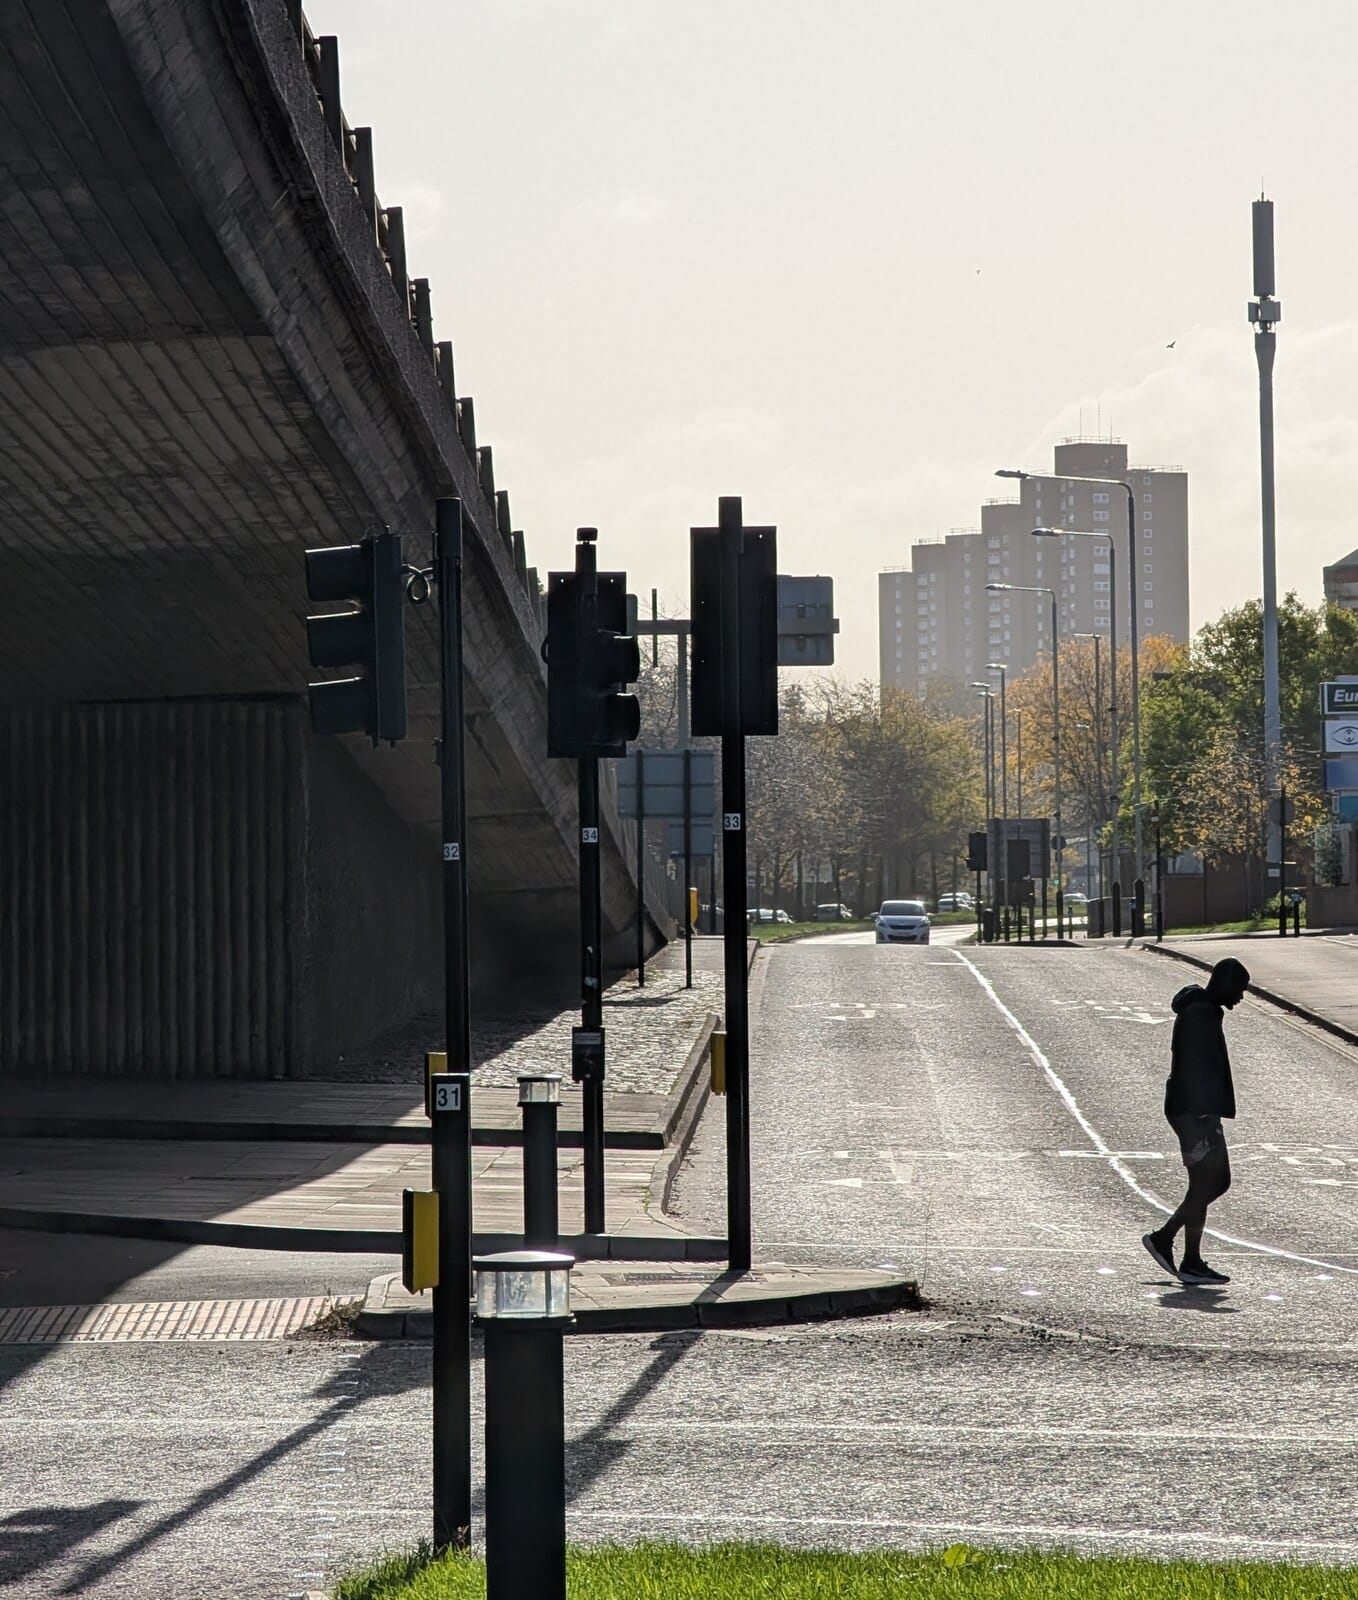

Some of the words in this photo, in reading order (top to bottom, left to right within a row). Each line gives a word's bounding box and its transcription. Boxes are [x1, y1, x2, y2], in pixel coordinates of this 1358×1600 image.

[725, 815, 739, 828] 33
[583, 829, 597, 841] 34
[444, 845, 458, 858] 32
[438, 1087, 459, 1107] 31
